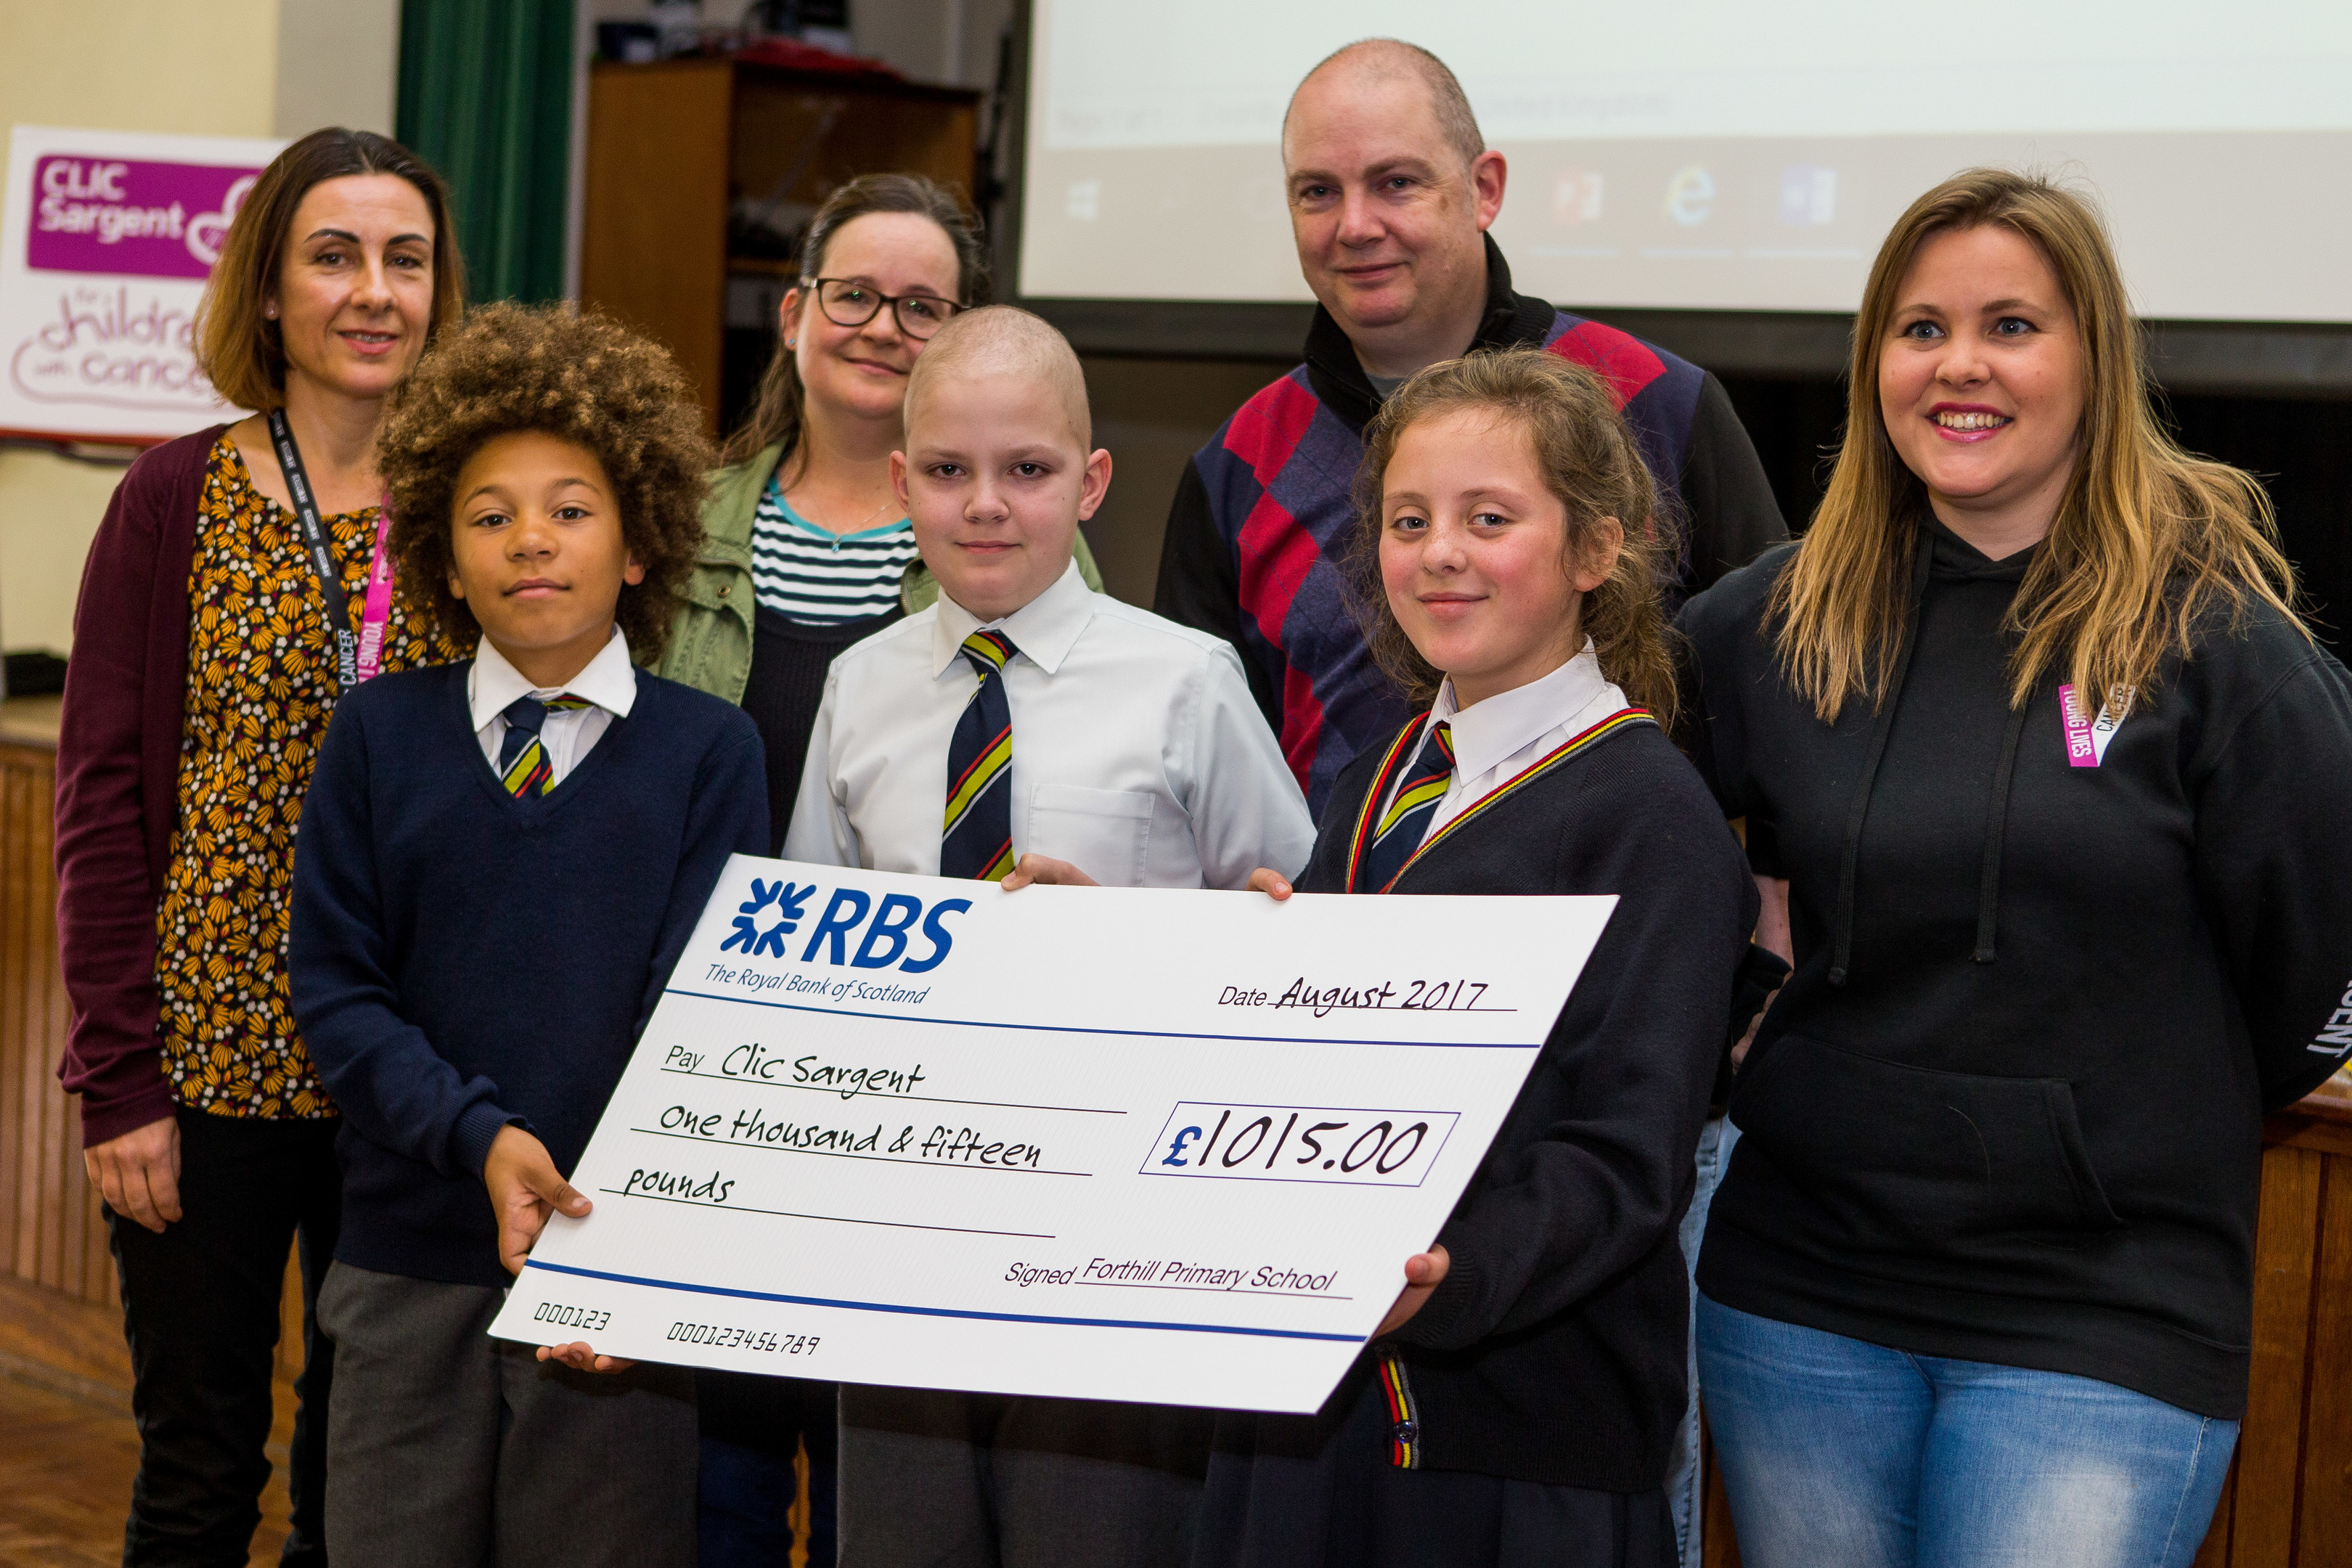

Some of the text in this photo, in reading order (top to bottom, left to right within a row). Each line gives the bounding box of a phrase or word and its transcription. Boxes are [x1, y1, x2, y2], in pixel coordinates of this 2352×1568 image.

[41, 160, 129, 200] CLIC
[38, 197, 186, 244] Sargent
[38, 285, 196, 354] childre
[80, 351, 211, 396] cance
[338, 628, 357, 685] CANCER
[358, 621, 384, 669] YOUNG
[2070, 729, 2092, 758] LIVES
[801, 888, 973, 973] RBS
[706, 963, 931, 1004] The Royal Bank of Scotland
[1218, 976, 1489, 1018] Date August 2017
[665, 1043, 926, 1100] Pay Clic Sargent
[660, 1105, 1042, 1168] One thousand & fifteen
[1161, 1109, 1429, 1174] £1015.00
[624, 1167, 735, 1203] pounds
[1005, 1257, 1338, 1291] Signed Forthill Primary School
[534, 1302, 821, 1356] 000123 000123456789
